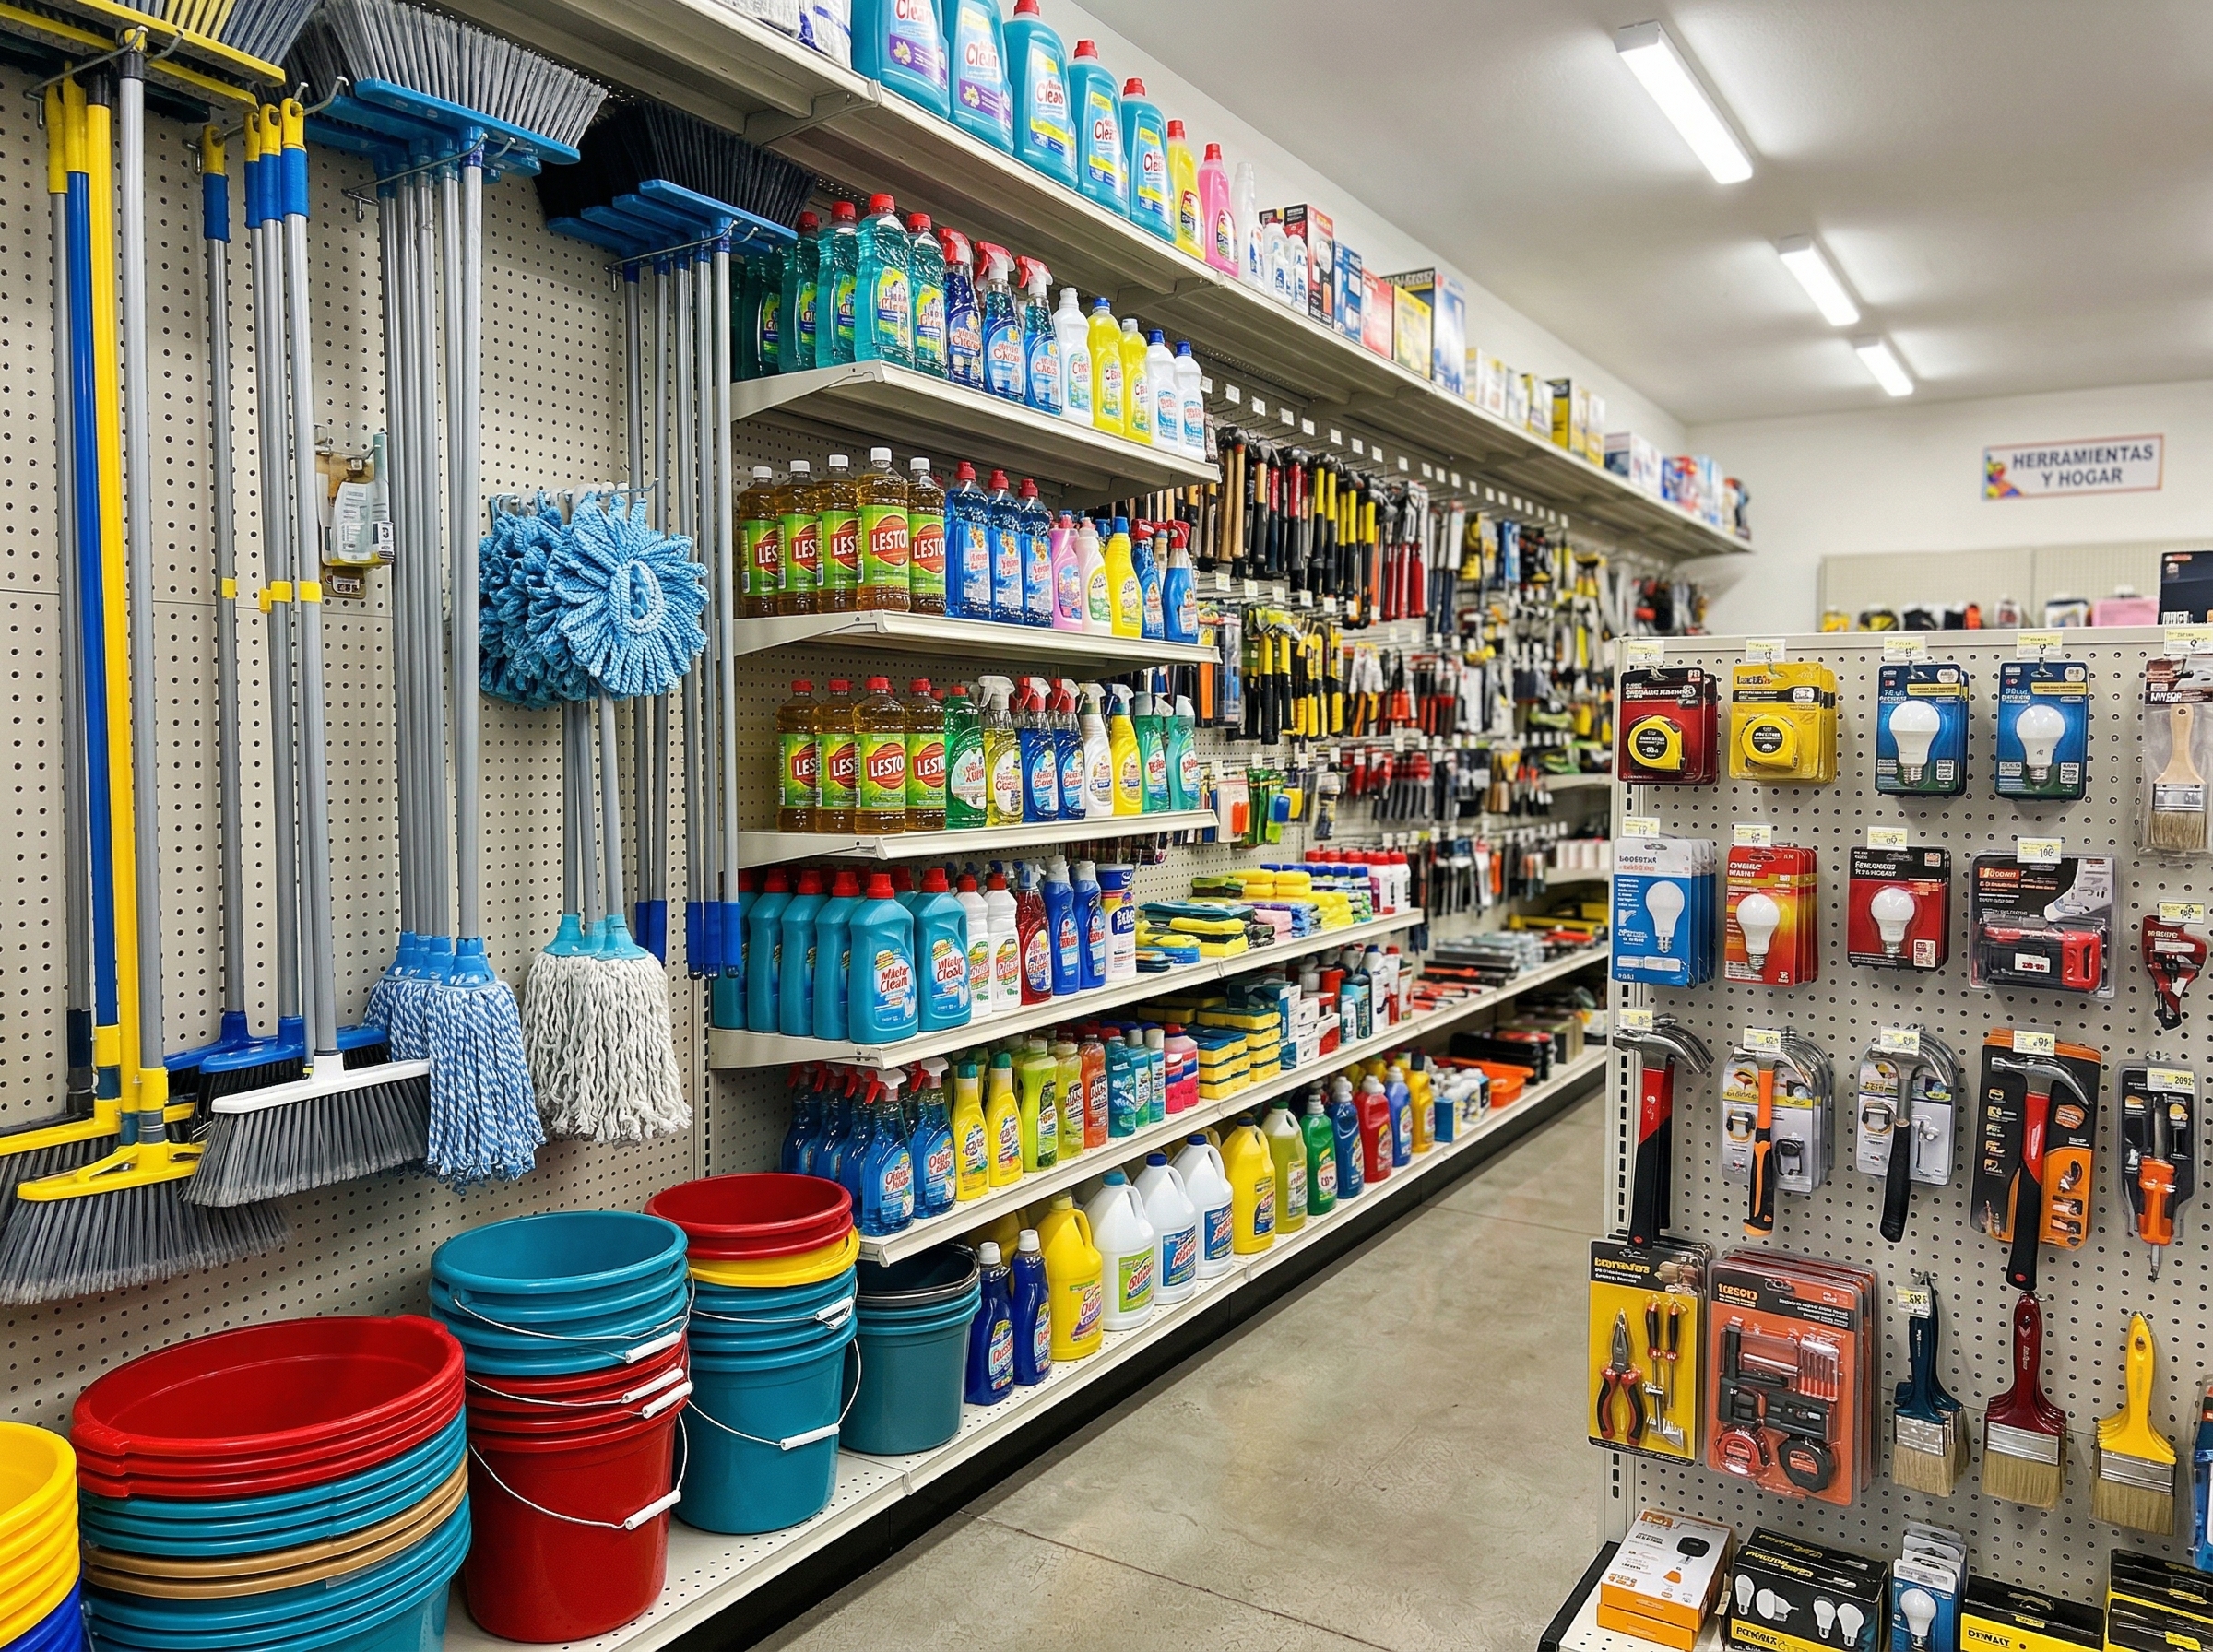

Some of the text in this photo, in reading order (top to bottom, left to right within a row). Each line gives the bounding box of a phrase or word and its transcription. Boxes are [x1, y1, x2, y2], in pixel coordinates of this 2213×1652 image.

[2013, 444, 2154, 469] HERRAMIENTAS
[2041, 467, 2123, 488] Y HOGAR
[795, 539, 815, 559] LES
[834, 535, 855, 555] LES
[872, 529, 908, 551] LESTO
[759, 545, 777, 563] LES
[796, 757, 816, 776] LES
[833, 758, 854, 776] LES
[880, 976, 908, 993] Clean
